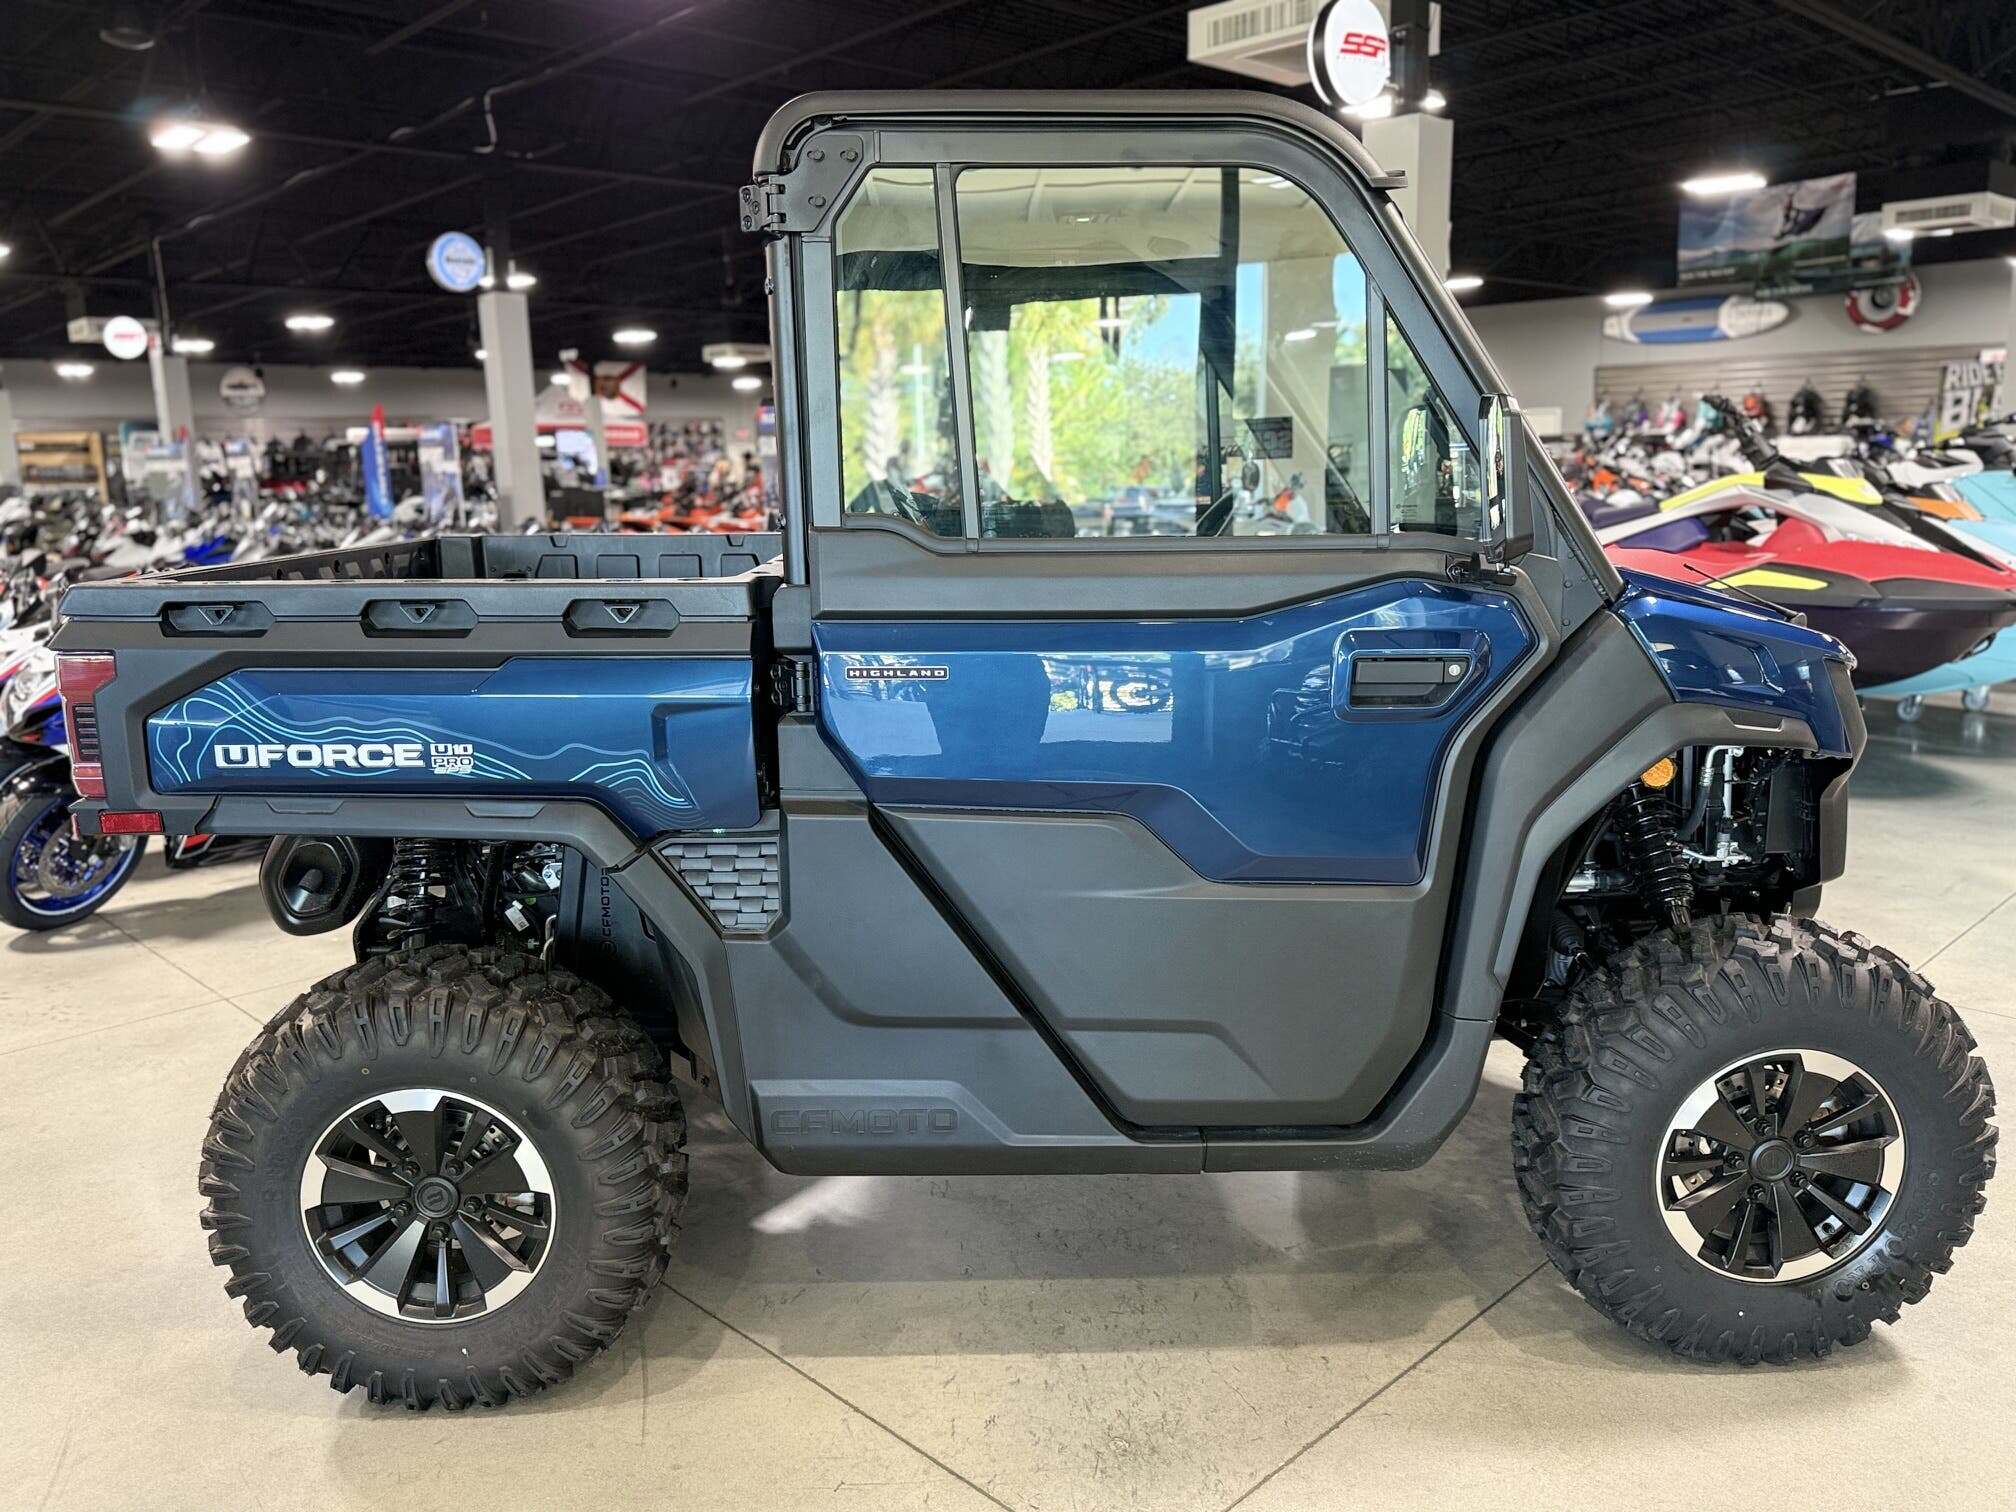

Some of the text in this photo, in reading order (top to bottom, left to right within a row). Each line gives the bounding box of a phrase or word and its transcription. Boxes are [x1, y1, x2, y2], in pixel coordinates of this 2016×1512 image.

[848, 669, 946, 678] HIGHLAND
[214, 743, 473, 768] UFORCE U10
[431, 756, 473, 767] PRO
[600, 875, 612, 938] CFMOTO
[770, 1108, 960, 1136] CFMOTO
